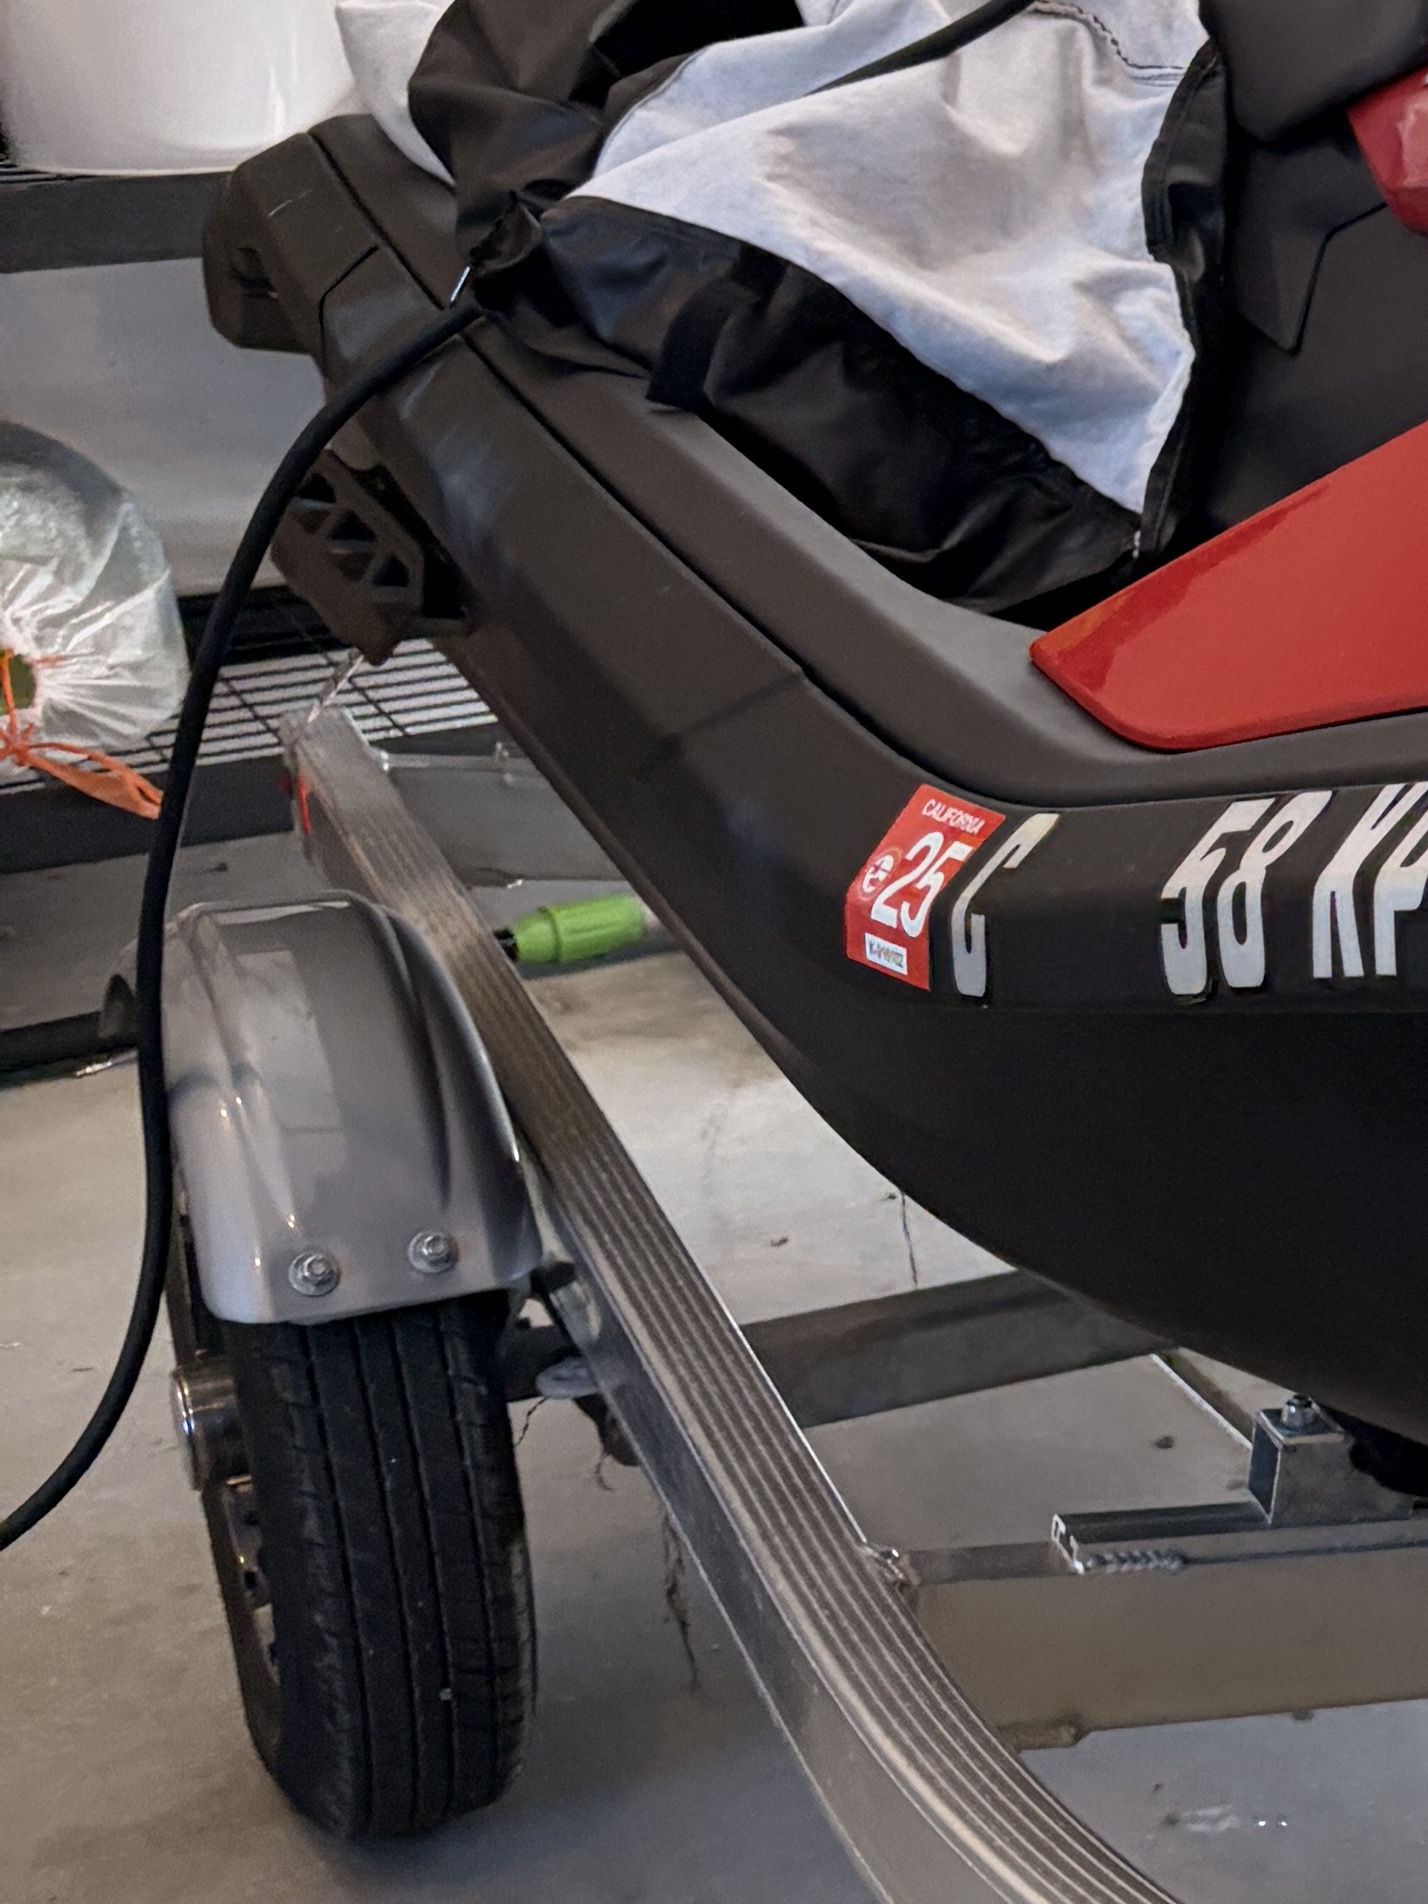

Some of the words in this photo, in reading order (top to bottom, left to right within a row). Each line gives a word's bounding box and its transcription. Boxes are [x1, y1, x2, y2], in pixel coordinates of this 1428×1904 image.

[921, 799, 986, 835] CALIFORNIA
[870, 831, 974, 939] 25
[1159, 790, 1334, 996] 58
